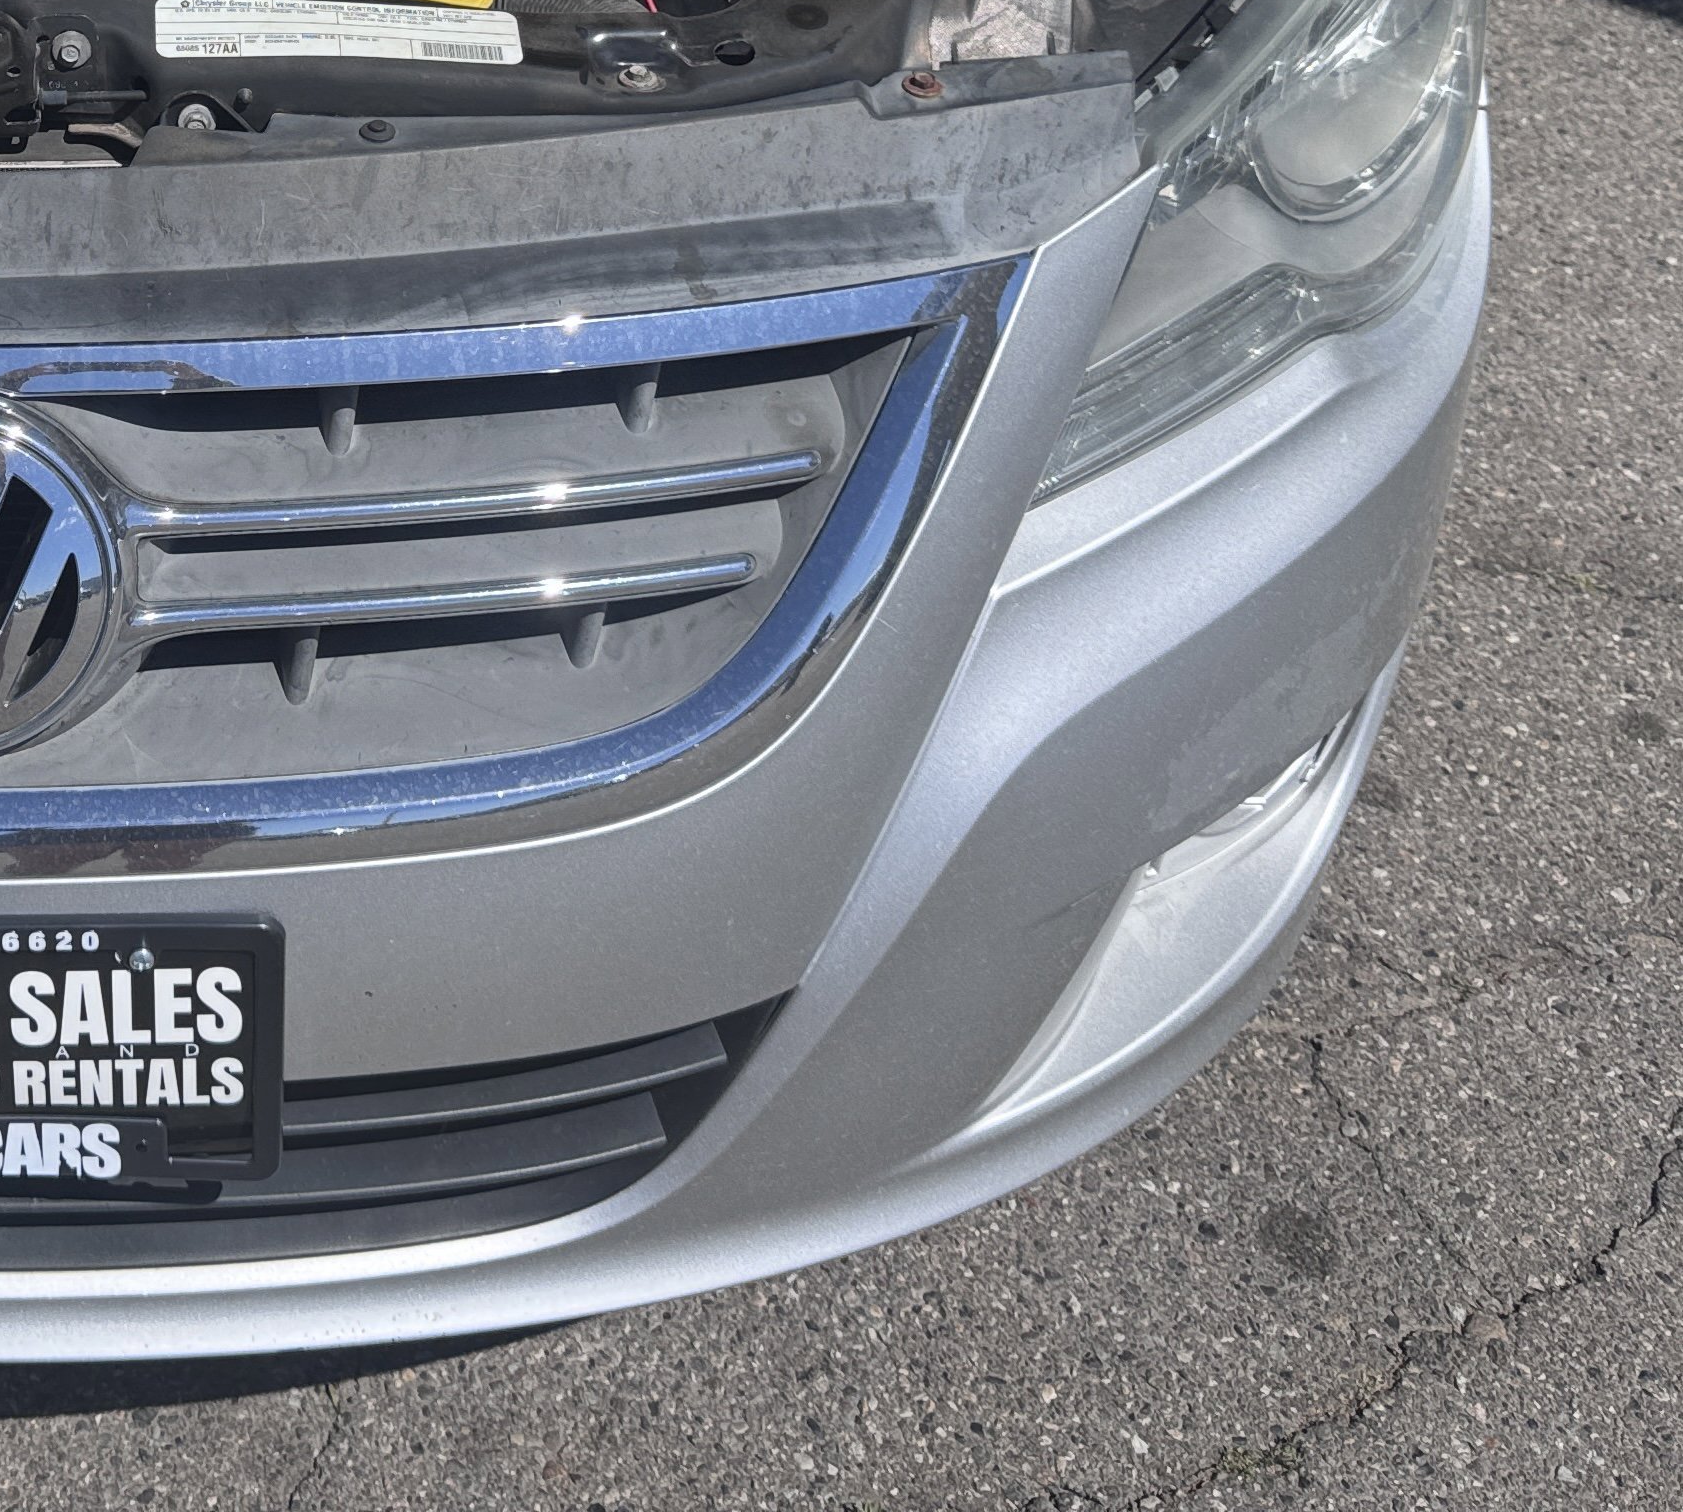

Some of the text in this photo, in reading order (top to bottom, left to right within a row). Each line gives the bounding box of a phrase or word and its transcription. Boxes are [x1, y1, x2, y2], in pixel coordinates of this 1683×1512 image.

[202, 42, 239, 55] 127AA
[9, 966, 243, 1047] SALES
[12, 1057, 244, 1107] RENTALS
